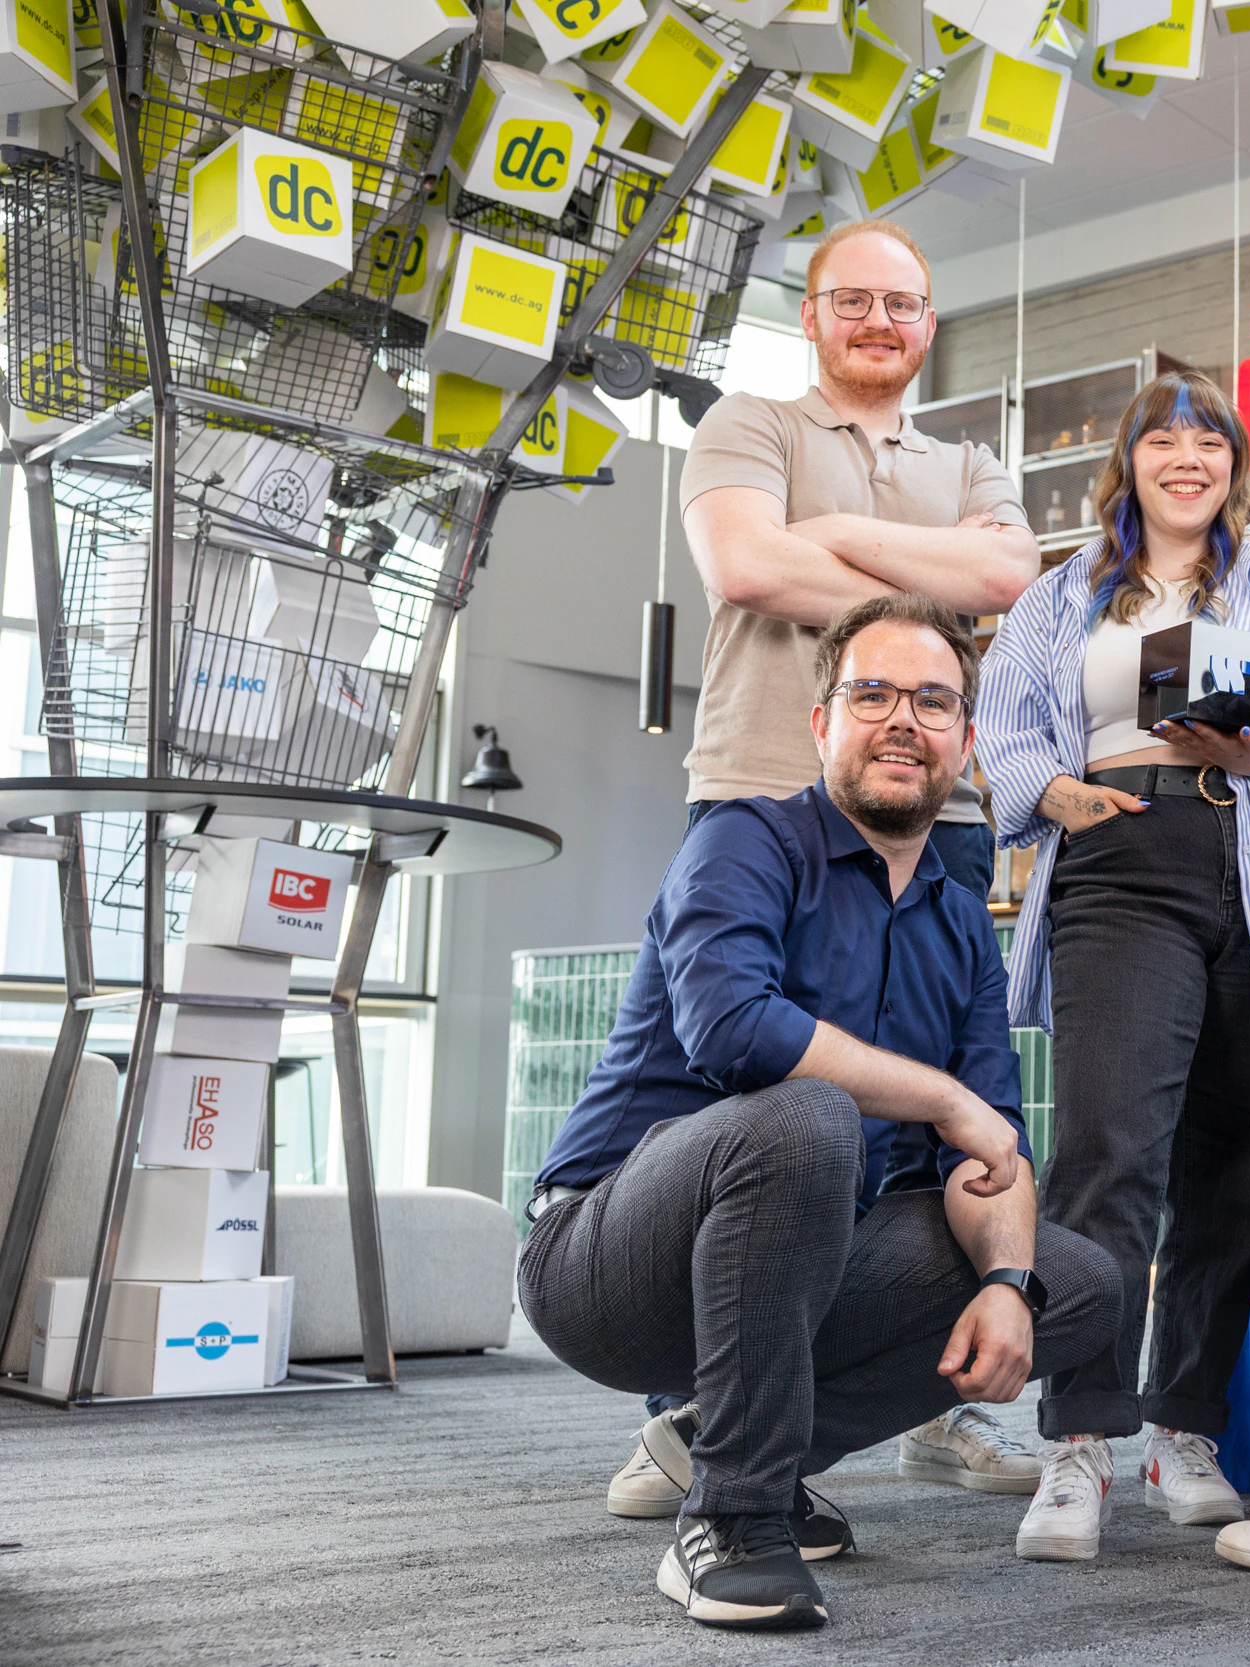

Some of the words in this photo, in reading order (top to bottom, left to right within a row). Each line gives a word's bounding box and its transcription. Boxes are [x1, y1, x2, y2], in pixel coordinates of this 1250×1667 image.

[500, 126, 565, 188] dc
[268, 163, 333, 232] dc
[474, 283, 543, 312] www.dc.ag
[275, 870, 317, 900] IBC
[277, 915, 323, 931] SOLAR
[195, 1076, 221, 1150] EHASO
[224, 1217, 259, 1232] PÖSSL
